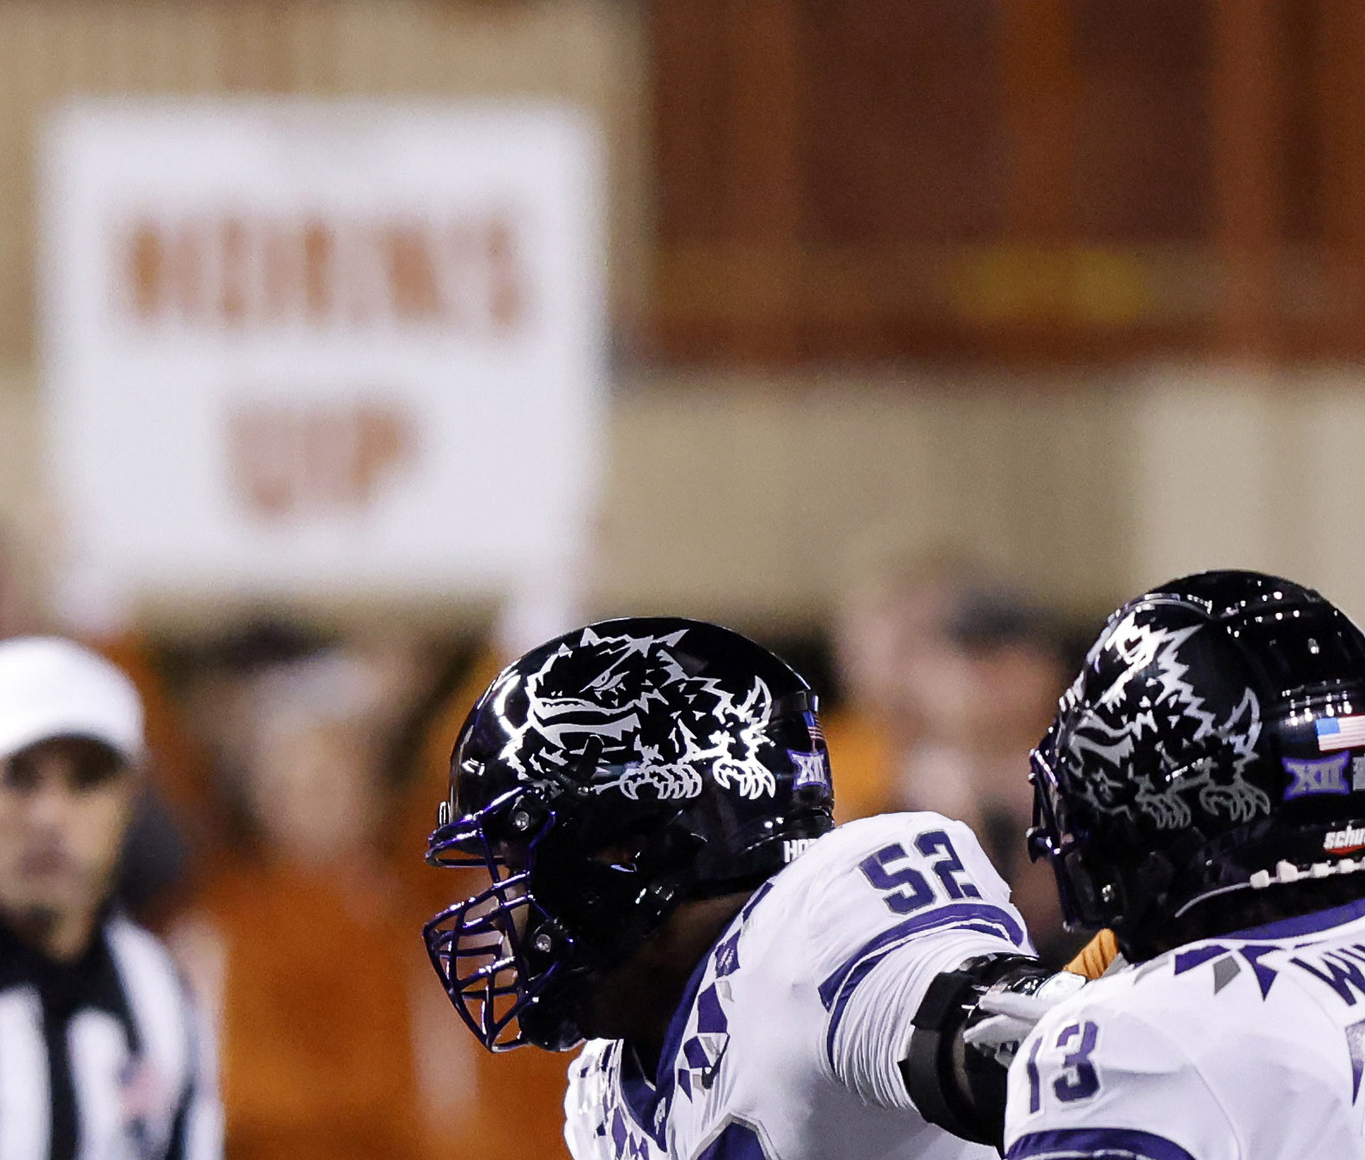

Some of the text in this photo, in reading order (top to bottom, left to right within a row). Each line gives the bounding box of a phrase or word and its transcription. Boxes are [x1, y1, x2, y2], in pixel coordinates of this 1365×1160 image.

[1283, 753, 1349, 797] XII
[858, 828, 985, 915] 52
[1026, 1021, 1102, 1115] 13
